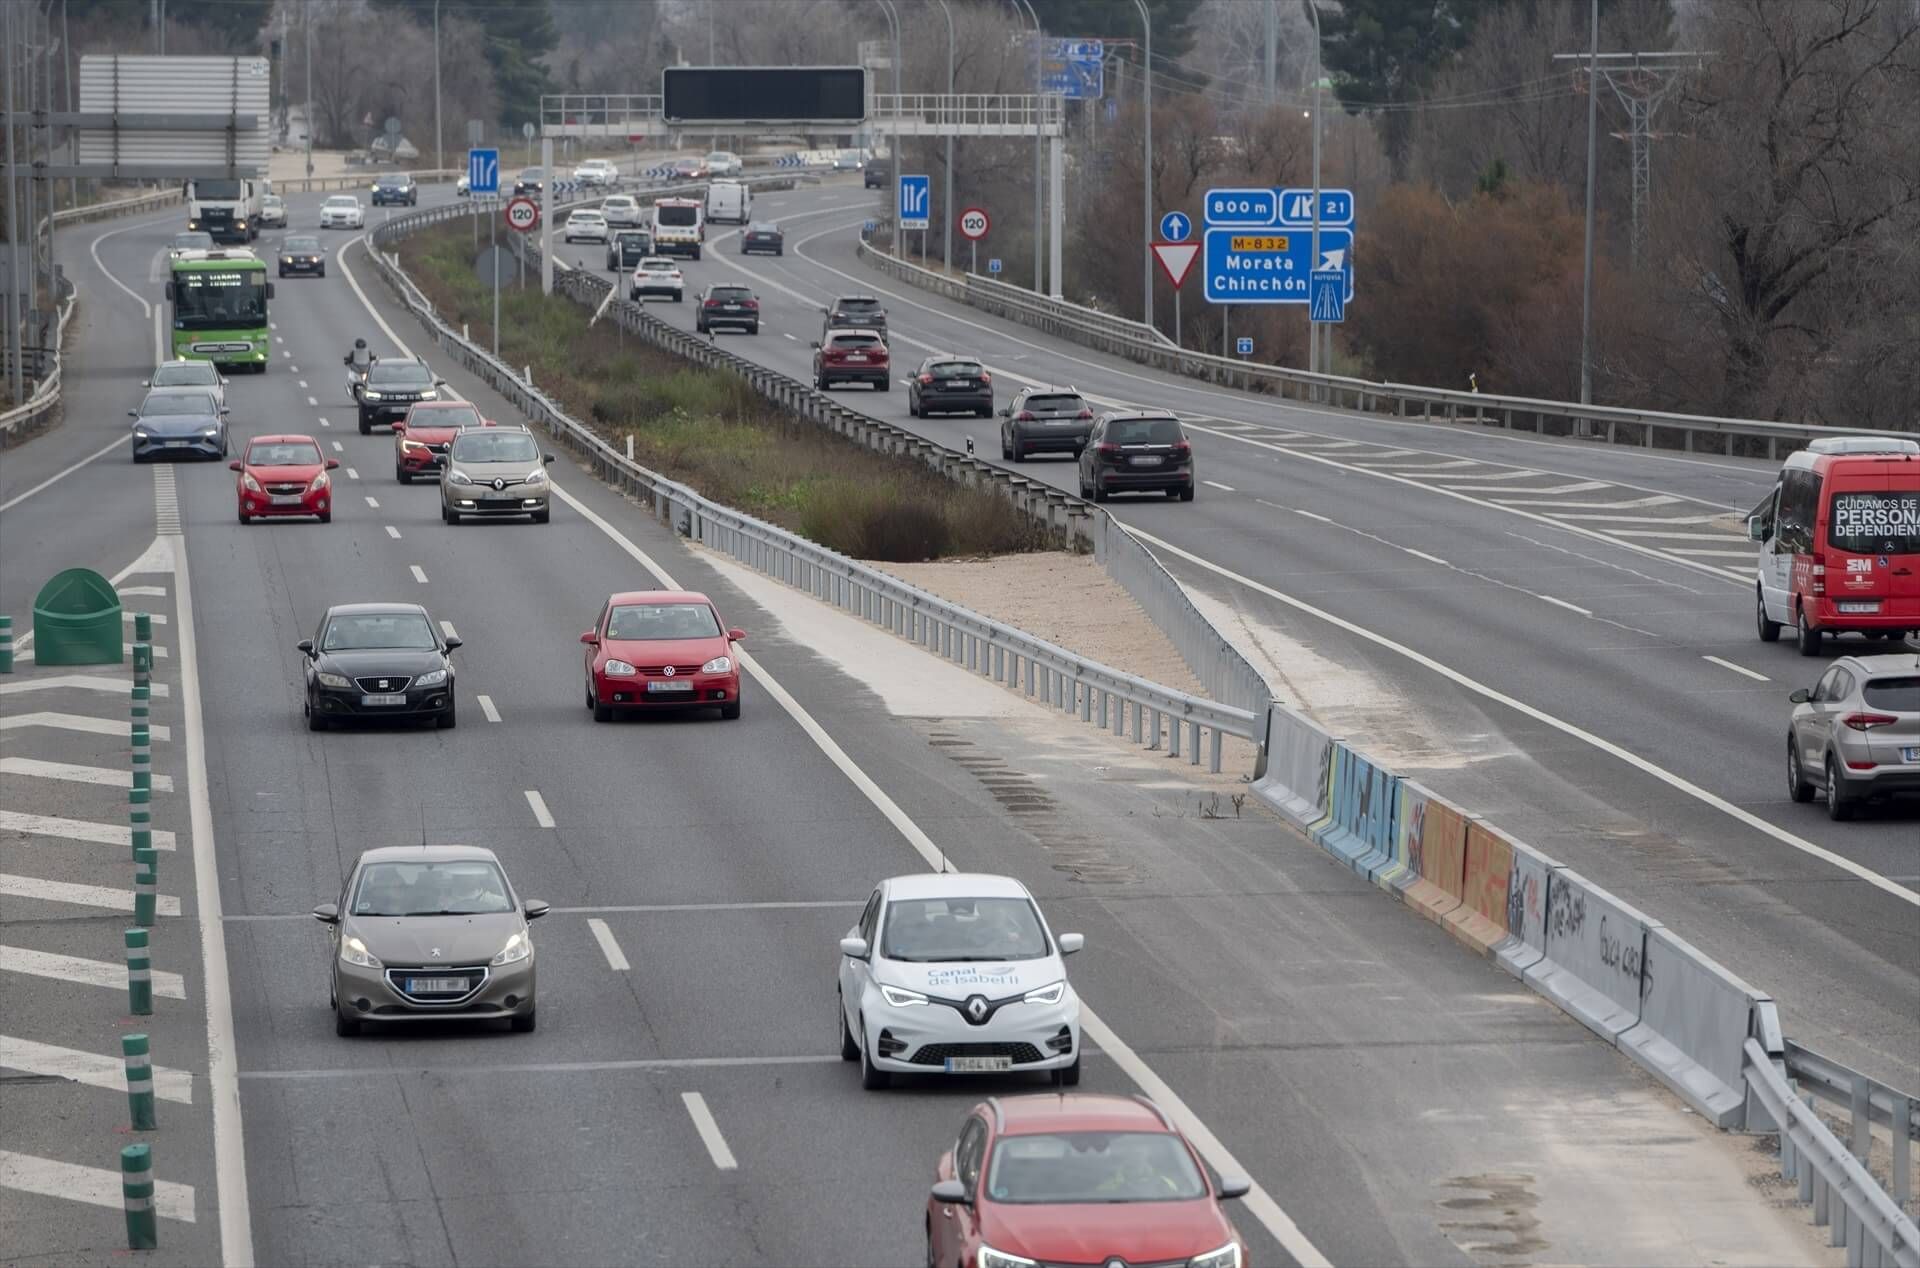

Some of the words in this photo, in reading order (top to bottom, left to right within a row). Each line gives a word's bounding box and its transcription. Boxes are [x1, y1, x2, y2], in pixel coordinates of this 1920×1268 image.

[1214, 200, 1250, 214] 800
[1254, 203, 1267, 214] m
[1326, 201, 1345, 214] 21
[512, 208, 532, 220] 120
[964, 218, 985, 229] 120
[1233, 237, 1287, 250] M-832
[1226, 255, 1294, 270] Morata
[1214, 274, 1306, 291] Chinchón
[1836, 499, 1899, 510] CUIDAMOS
[1901, 499, 1917, 509] DE
[1836, 509, 1920, 525] PERSON
[927, 967, 977, 977] Canal
[928, 975, 951, 986] de
[954, 975, 1006, 986] Isabel
